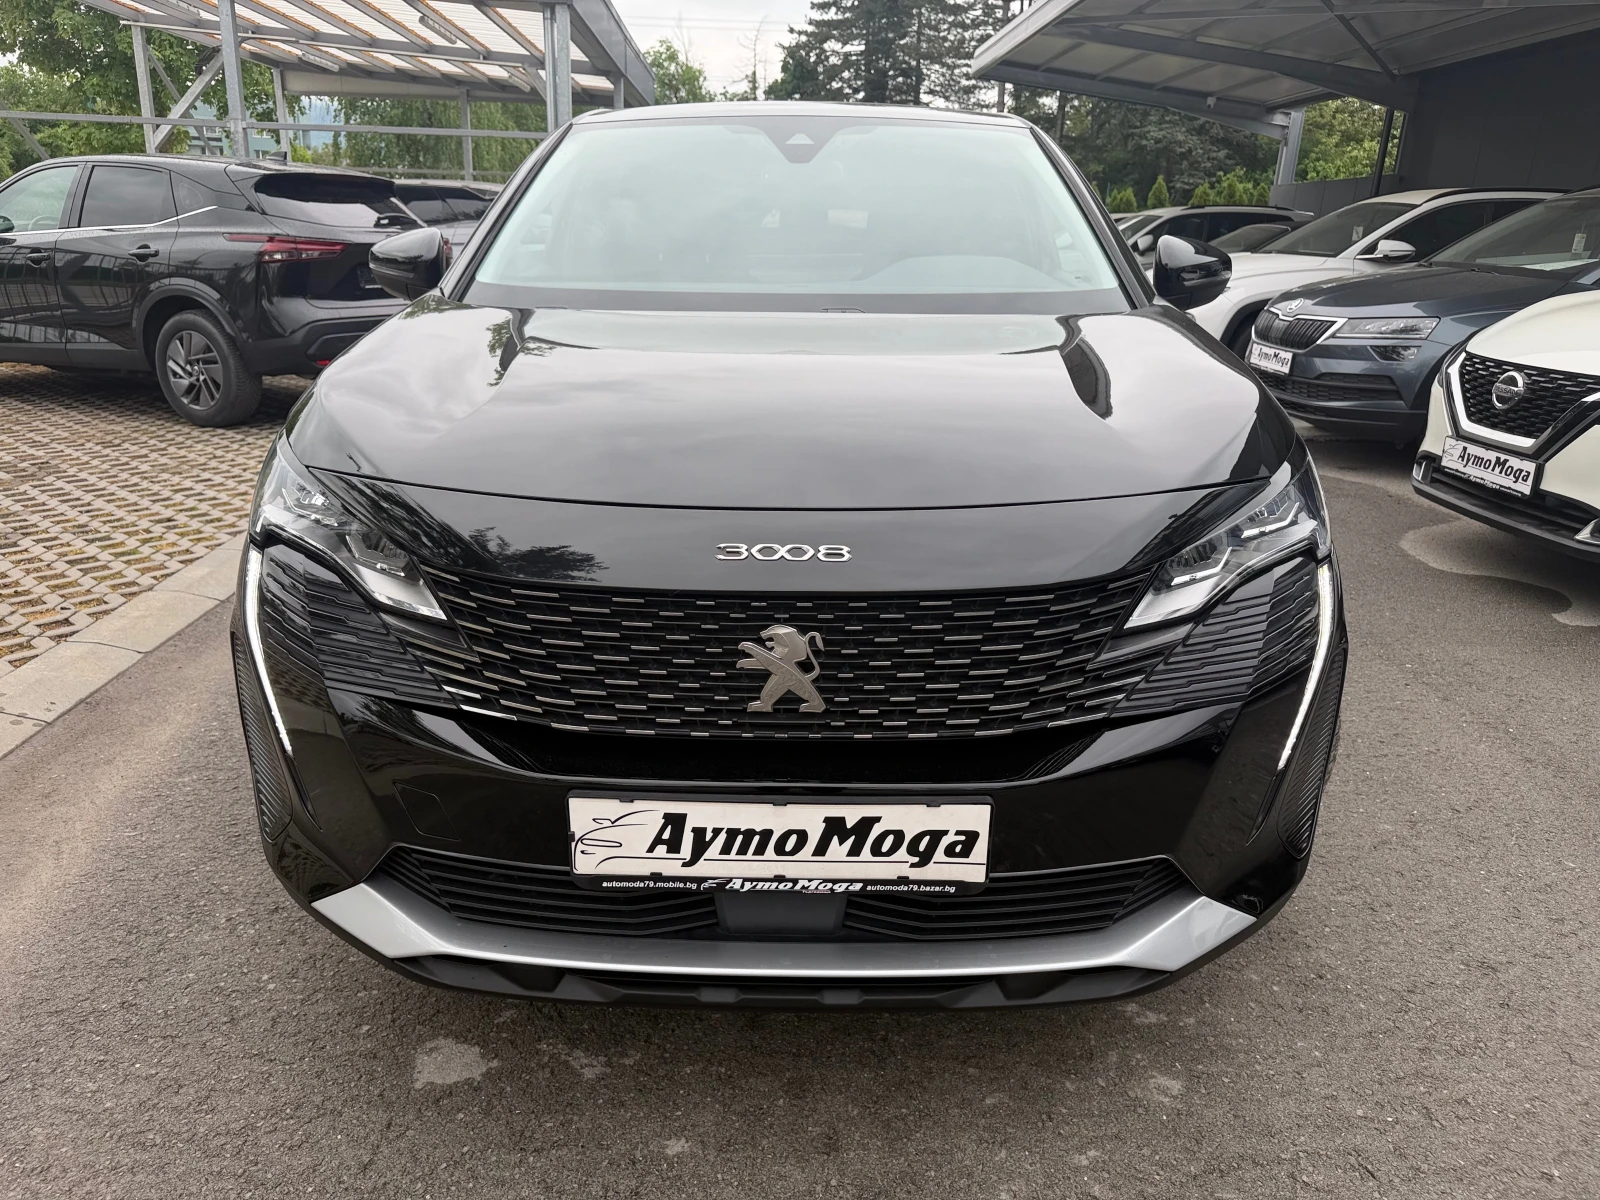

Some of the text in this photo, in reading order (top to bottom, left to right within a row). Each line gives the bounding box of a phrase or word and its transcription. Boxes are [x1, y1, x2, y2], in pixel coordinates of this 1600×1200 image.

[714, 543, 852, 562] 3008
[602, 880, 698, 890] automoda79.mobile.bg
[866, 884, 956, 893] automoda79.bazar.bg
